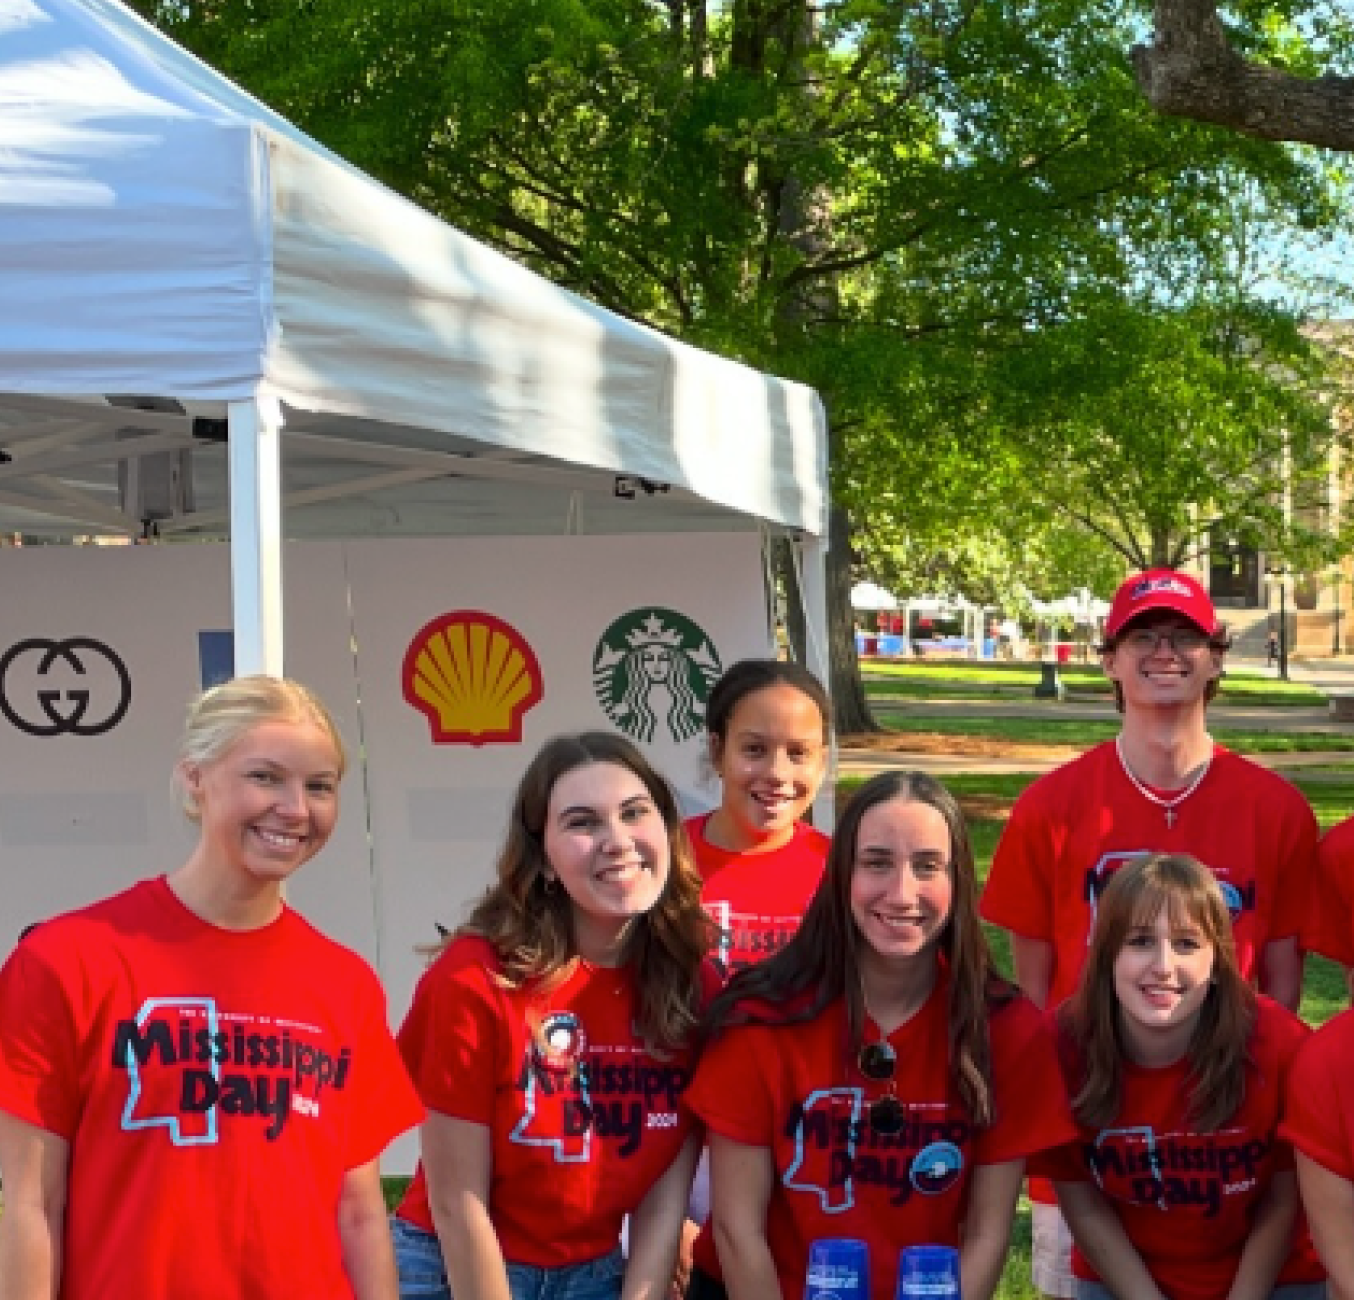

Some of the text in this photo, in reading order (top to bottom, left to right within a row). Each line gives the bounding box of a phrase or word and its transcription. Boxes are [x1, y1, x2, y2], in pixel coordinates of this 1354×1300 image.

[112, 1018, 351, 1097] Mississippi
[181, 1068, 290, 1142] Day
[563, 1098, 643, 1160] Day
[834, 1150, 913, 1207] Day
[1084, 1140, 1273, 1182] Mississipp
[1131, 1178, 1220, 1218] Day
